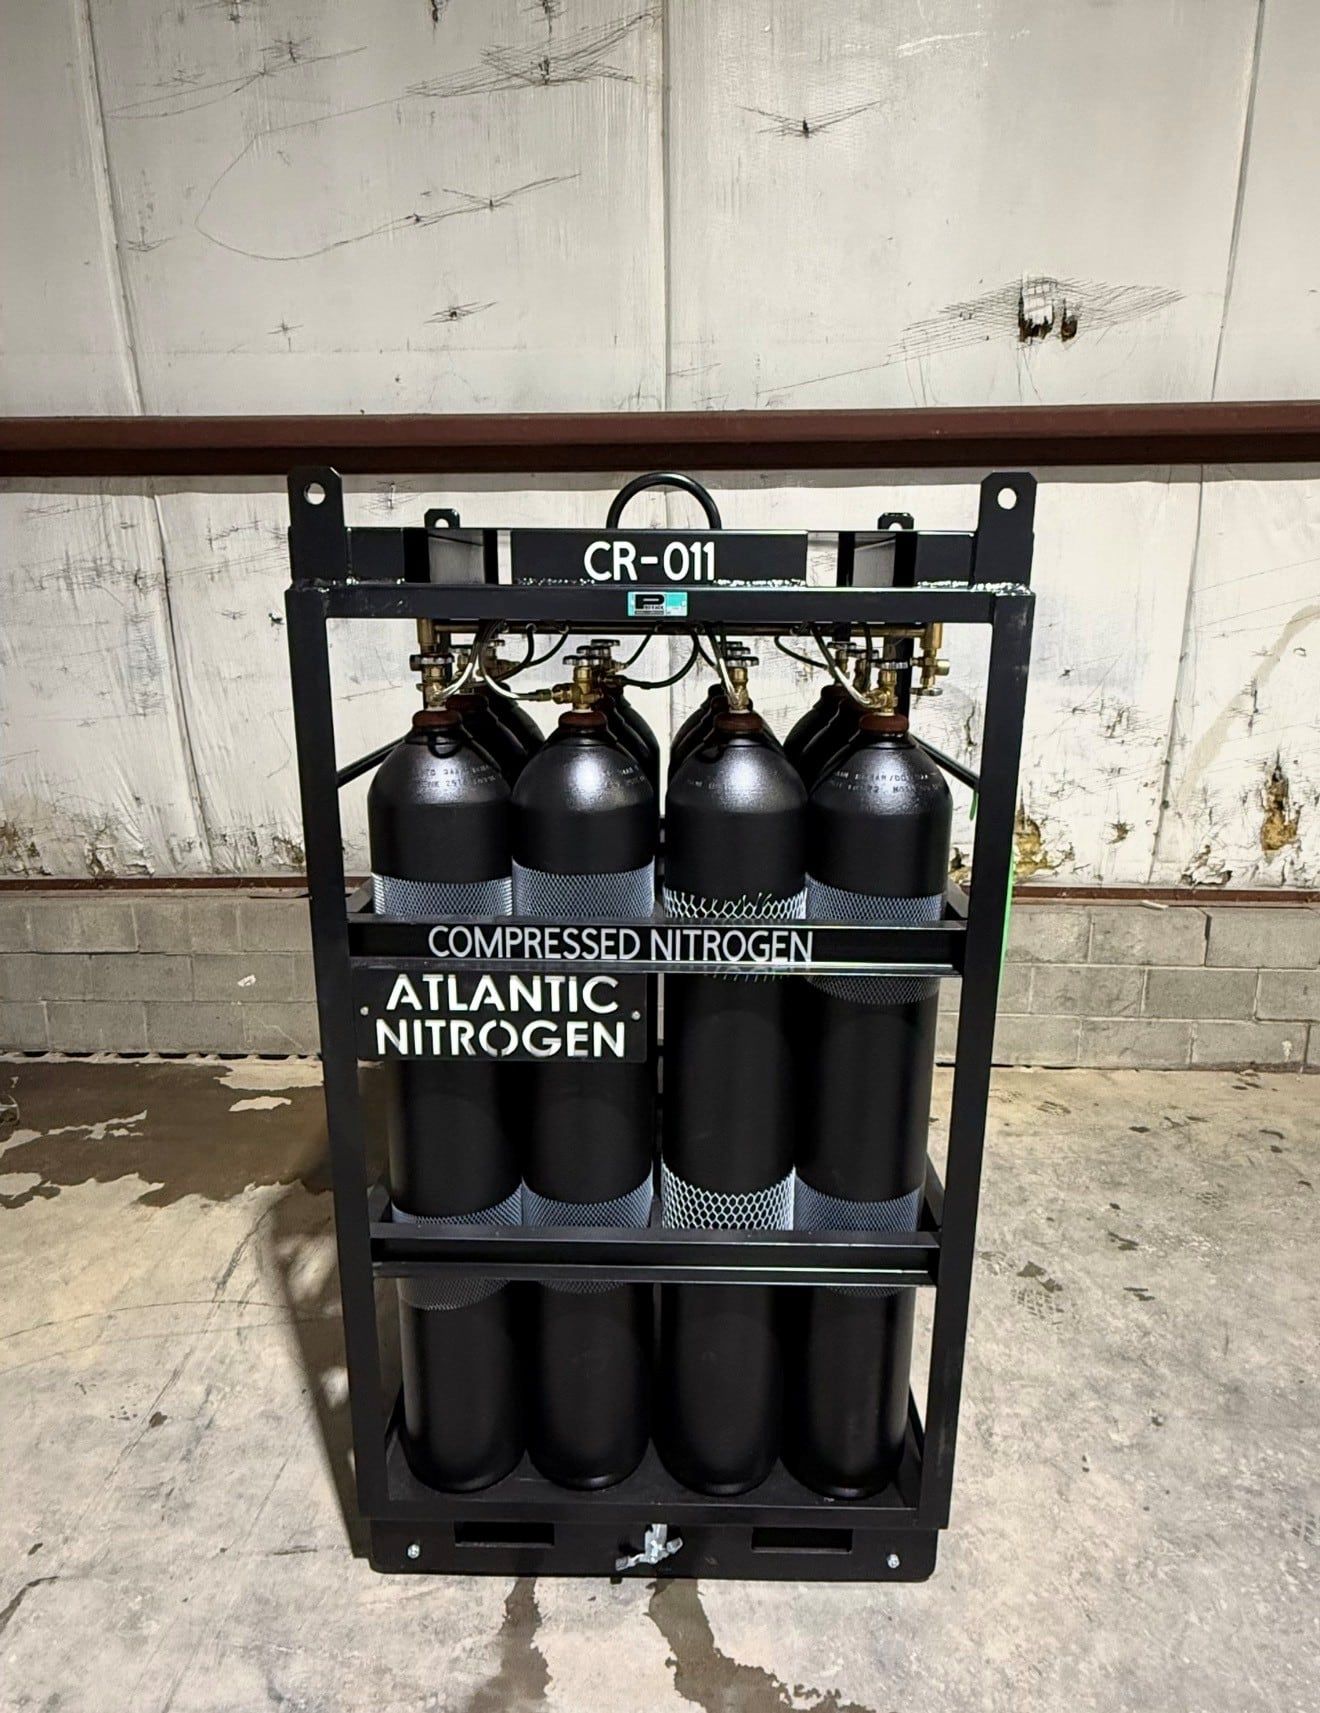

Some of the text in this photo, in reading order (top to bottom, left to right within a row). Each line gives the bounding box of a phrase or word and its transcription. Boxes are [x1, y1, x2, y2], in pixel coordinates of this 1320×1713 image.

[584, 541, 715, 581] CR-011
[428, 925, 814, 963] COMPRESSED NITROGEN
[386, 973, 619, 1014] ATLANTIC
[376, 1019, 625, 1058] NITROGEN
